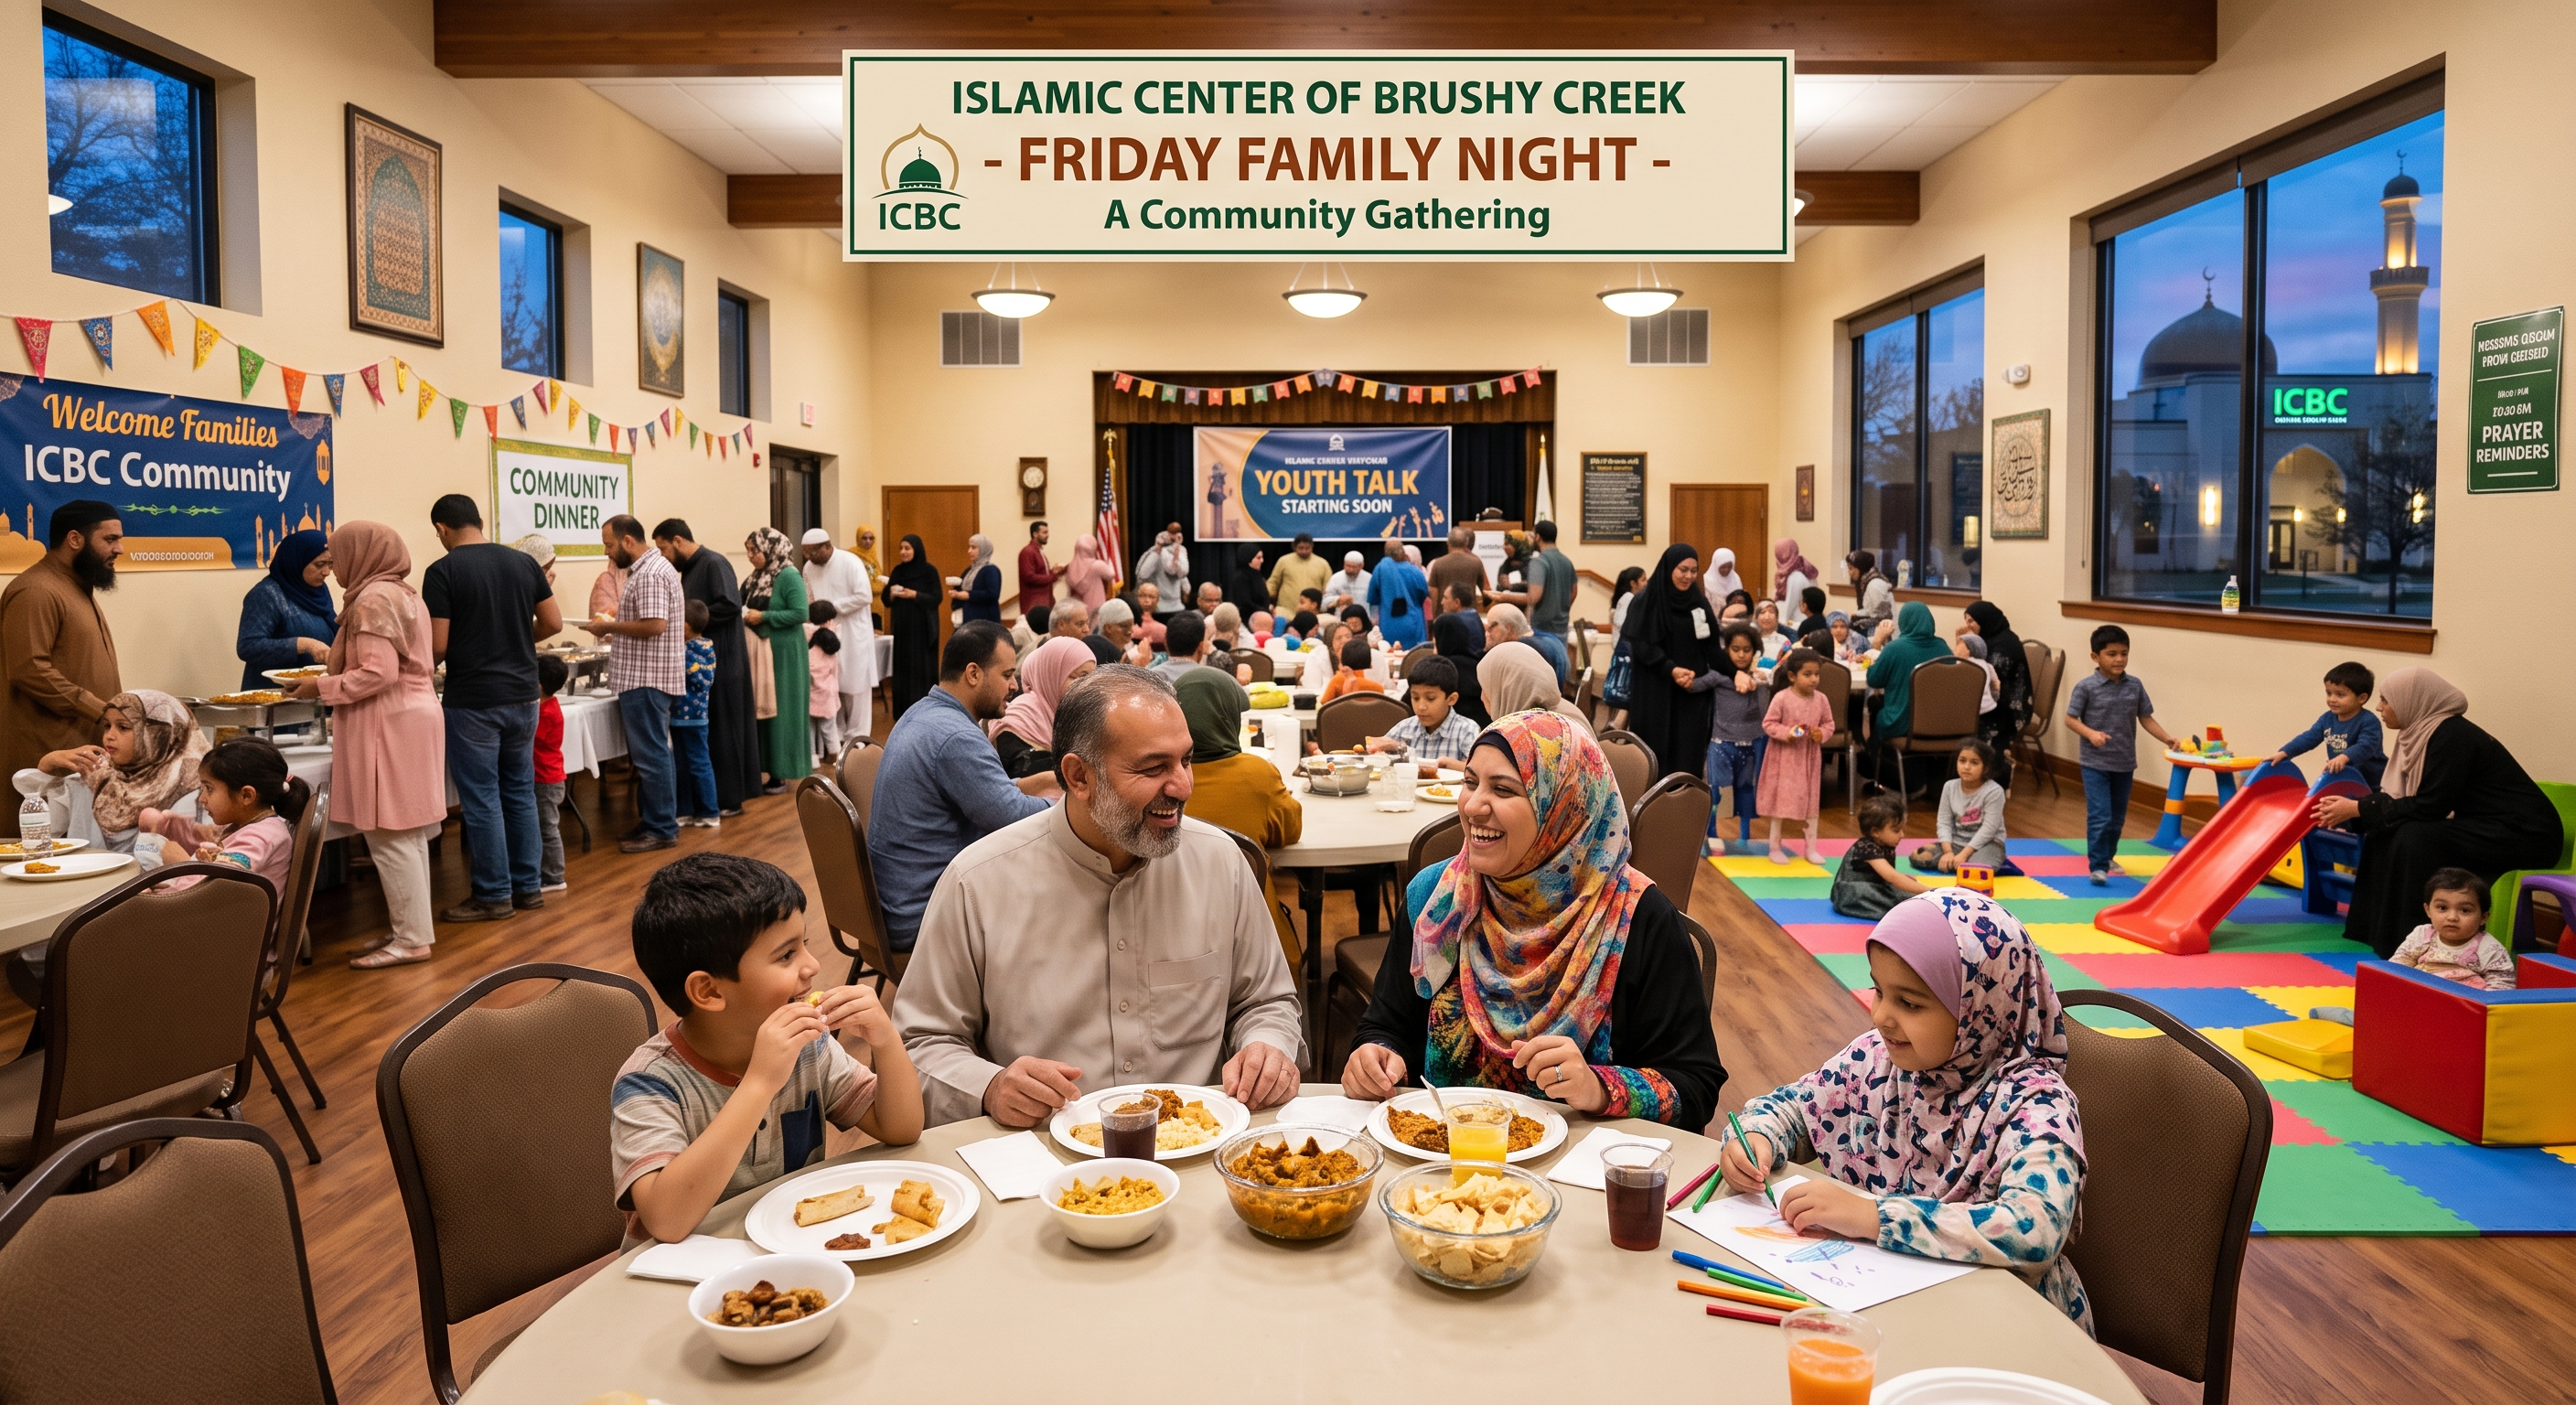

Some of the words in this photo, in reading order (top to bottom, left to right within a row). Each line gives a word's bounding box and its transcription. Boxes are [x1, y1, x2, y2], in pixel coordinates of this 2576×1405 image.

[954, 80, 1122, 115] ISLAMIC
[1134, 80, 1294, 115] CENTER
[1306, 80, 1360, 115] OF
[1375, 80, 1542, 115] BRUSHY
[1554, 80, 1686, 115] CREEK
[1021, 136, 1221, 182] FRIDAY
[1240, 136, 1442, 181] FAMILY
[1459, 136, 1637, 182] NIGHT
[880, 202, 961, 231] ICBC
[1104, 199, 1130, 230] A
[1141, 198, 1356, 239] Community
[1366, 198, 1549, 239] Gathering
[2273, 388, 2348, 415] ICBC
[43, 393, 176, 438] Welcome
[180, 409, 279, 448] Families
[2482, 421, 2543, 444] PRAYER
[2476, 443, 2549, 463] REMINDERS
[25, 444, 112, 486] ICBC
[120, 452, 291, 502] Community
[510, 467, 618, 499] COMMUNITY
[1254, 470, 1346, 495] YOUTH
[1353, 470, 1419, 495] TALK
[534, 503, 600, 530] DINNER
[1282, 499, 1349, 513] STARTING
[1352, 499, 1392, 513] SOON
